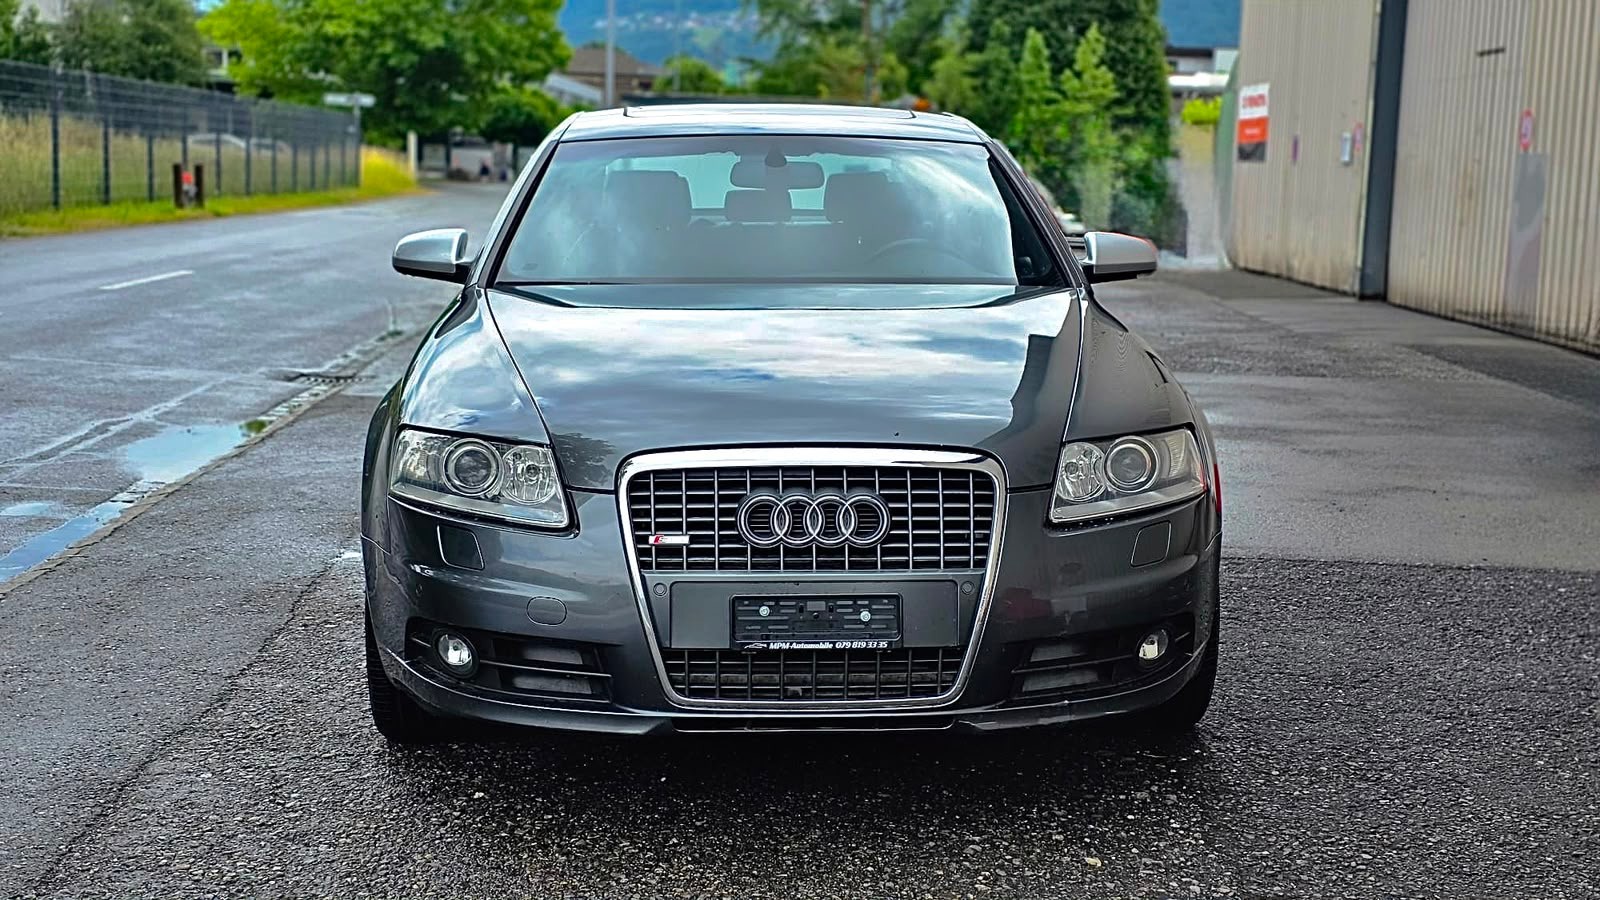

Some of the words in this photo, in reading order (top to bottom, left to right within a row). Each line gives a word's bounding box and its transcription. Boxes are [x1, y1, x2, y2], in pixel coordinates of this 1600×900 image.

[835, 641, 851, 649] 079
[852, 641, 866, 649] 819
[867, 641, 877, 649] 33
[877, 641, 888, 649] 35
